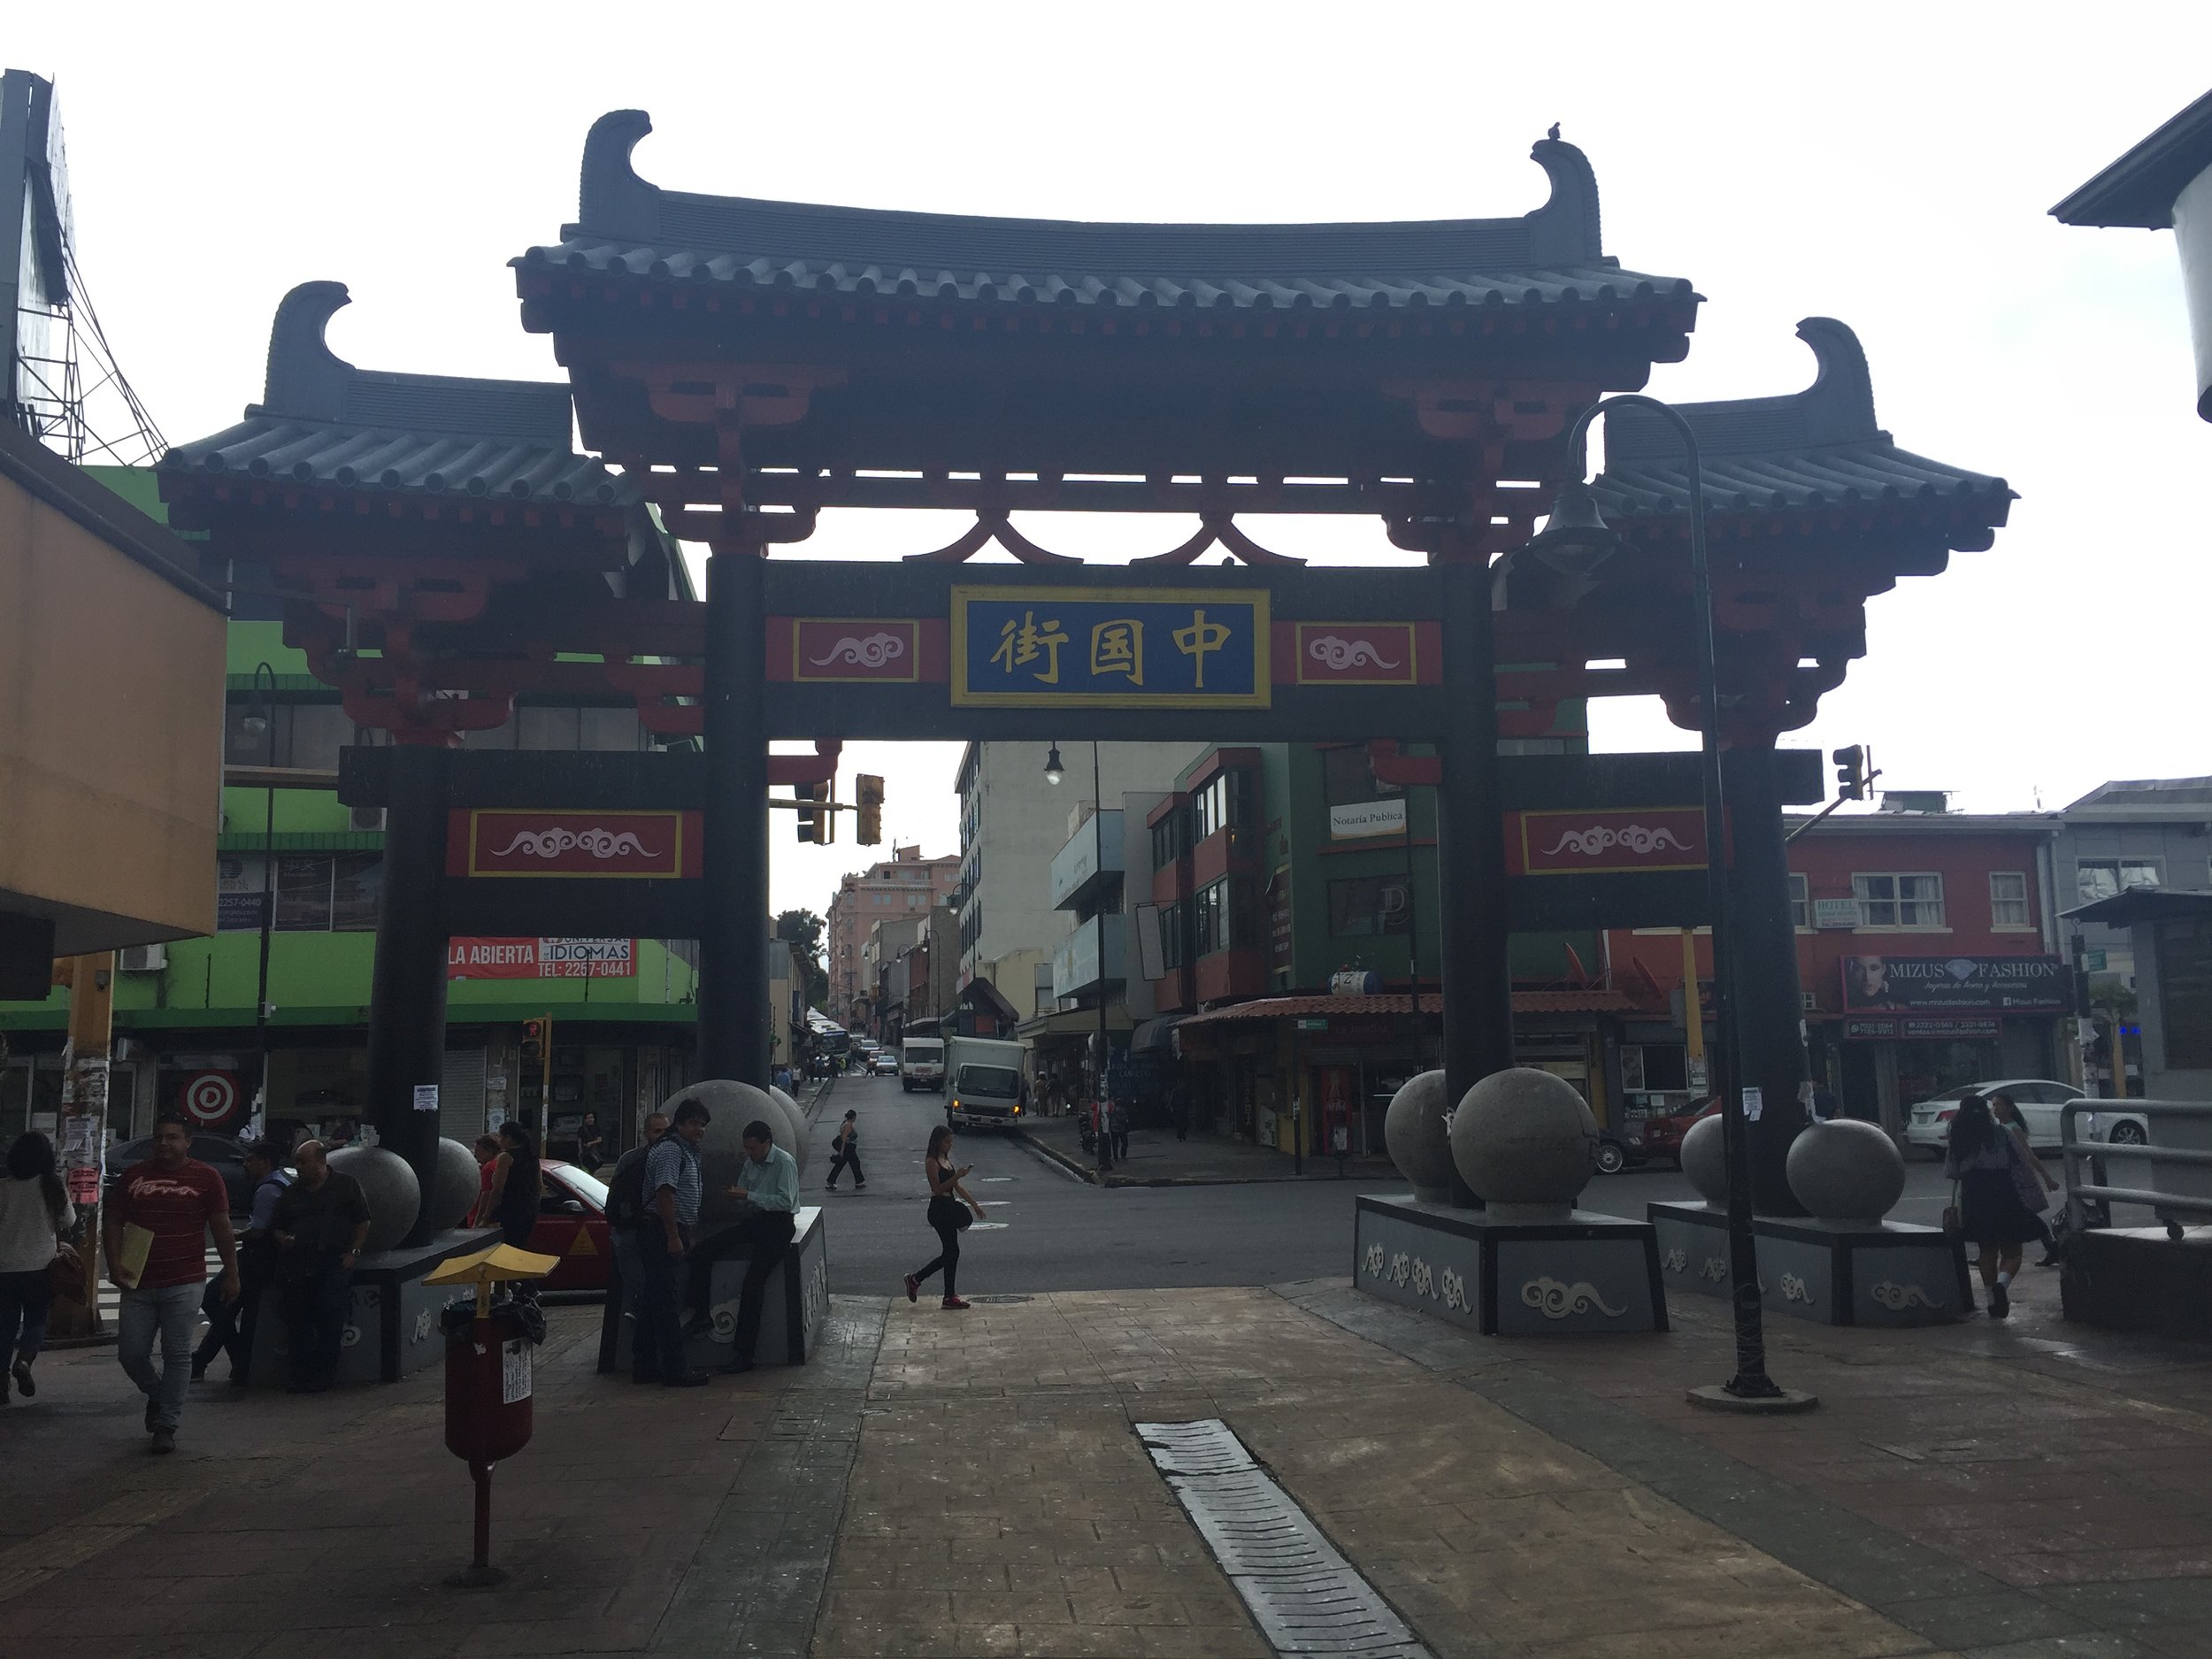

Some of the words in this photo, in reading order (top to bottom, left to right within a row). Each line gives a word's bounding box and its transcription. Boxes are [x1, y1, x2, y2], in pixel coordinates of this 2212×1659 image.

[1333, 815, 1367, 826] Notaría
[1817, 900, 1855, 910] HOTEL
[470, 945, 534, 964] ABIERTA
[550, 945, 629, 960] IDIOMAS
[538, 963, 561, 978] TEL:
[565, 962, 631, 978] 2257-0441
[1890, 963, 1945, 978] MIZUS
[1978, 963, 2055, 978] FASHION
[1985, 983, 1990, 993] y
[2033, 997, 2062, 1006] Fashion
